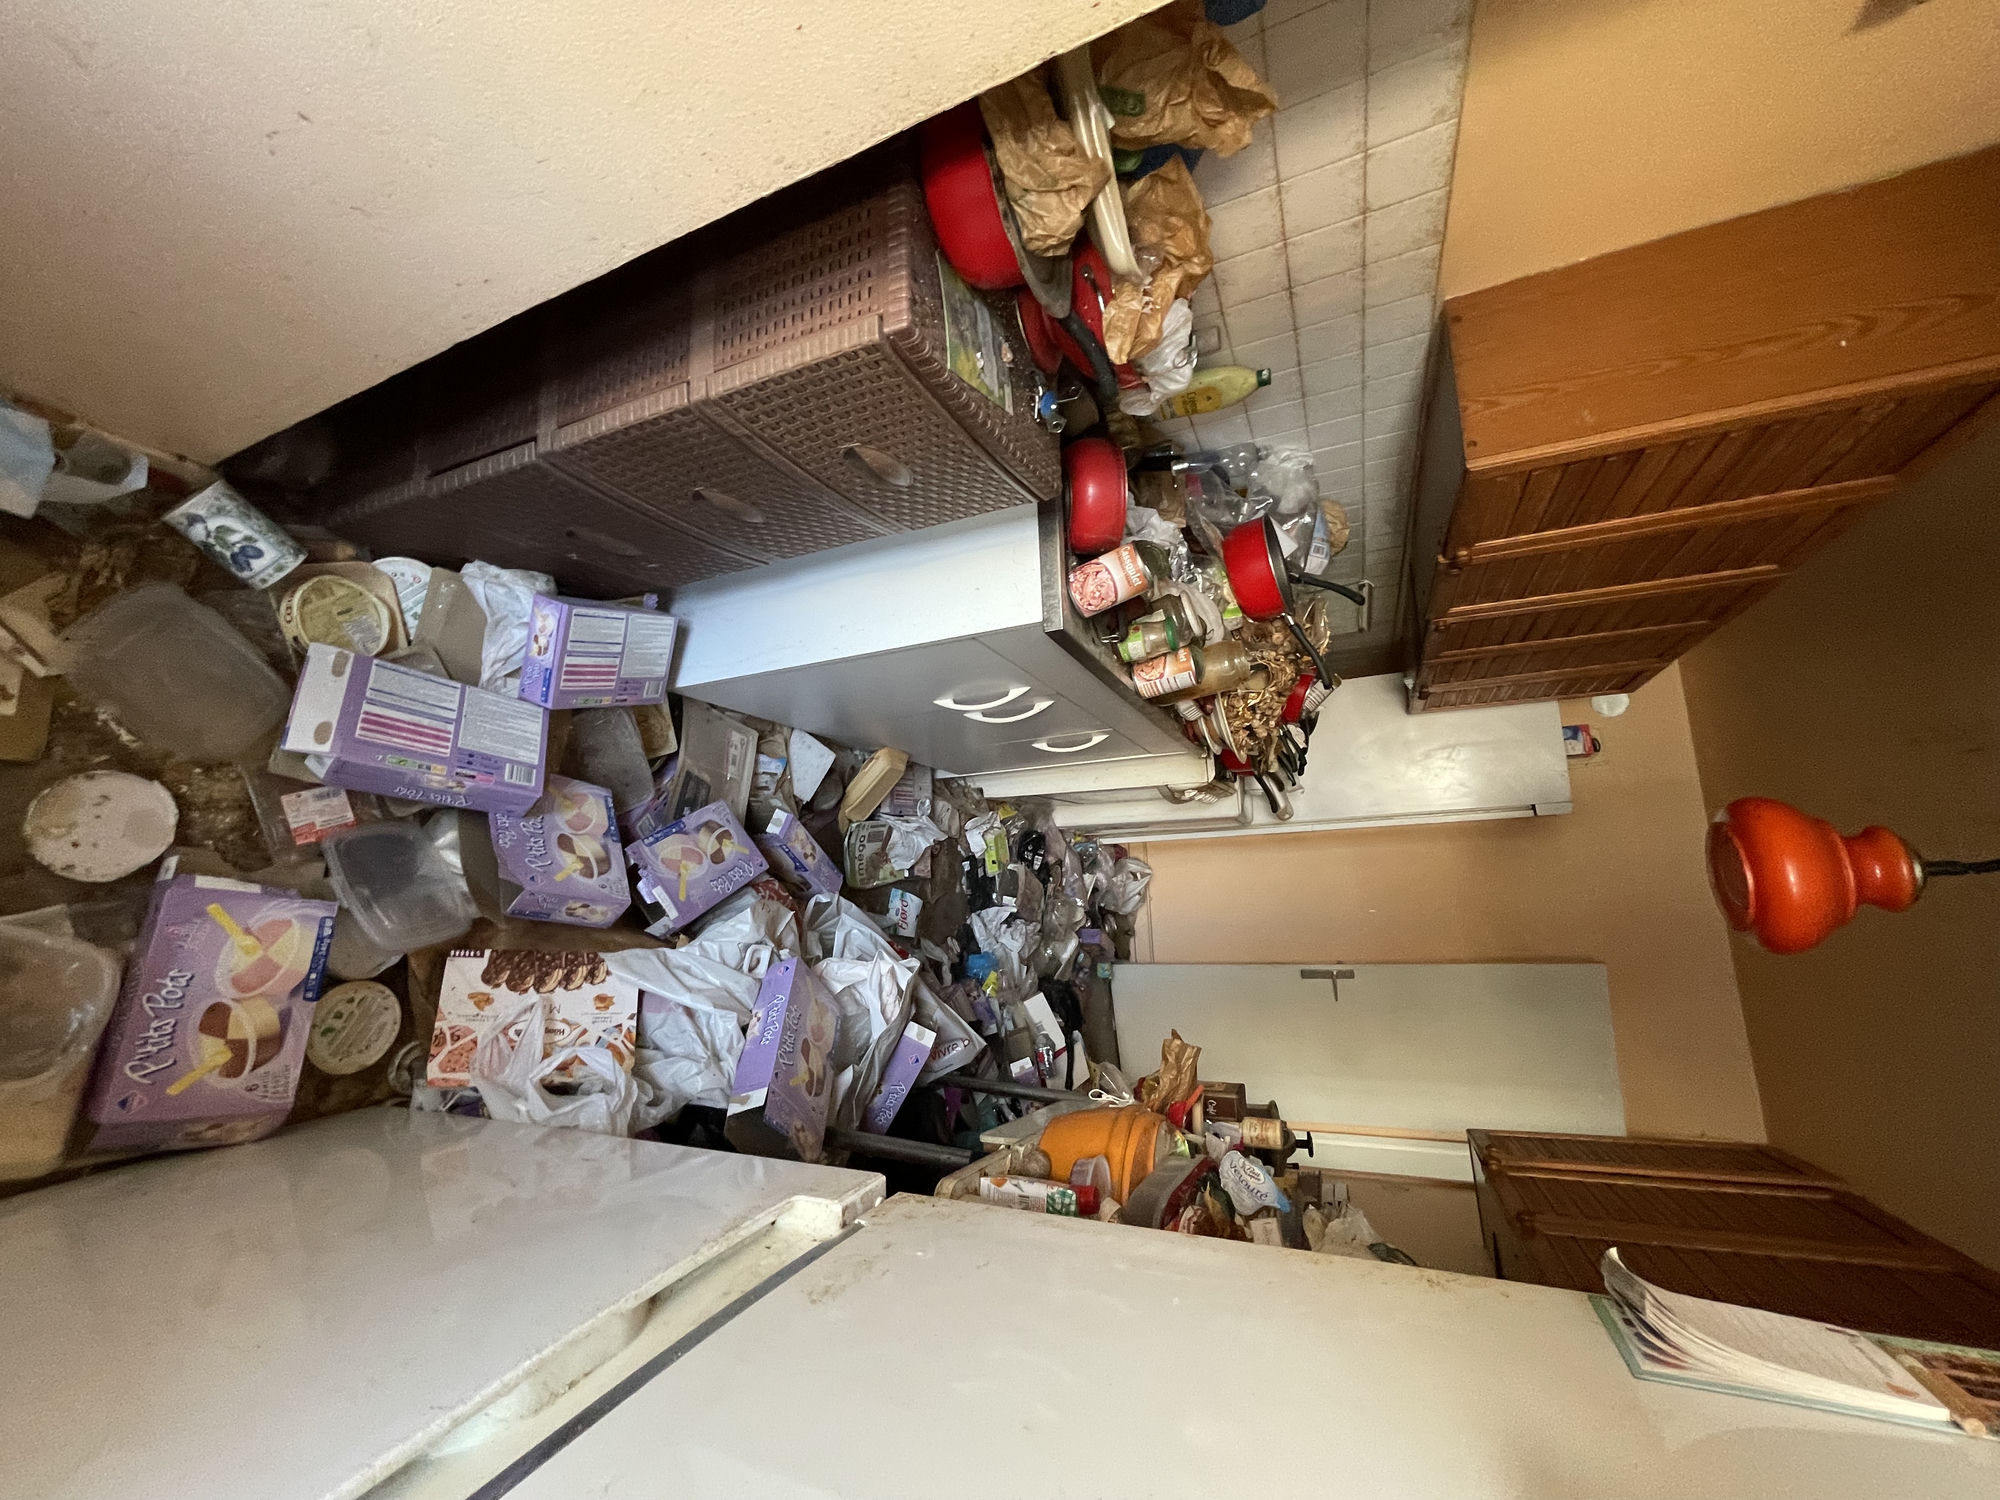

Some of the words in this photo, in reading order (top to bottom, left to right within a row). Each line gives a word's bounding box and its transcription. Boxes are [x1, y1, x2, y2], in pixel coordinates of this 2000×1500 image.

[1121, 546, 1142, 587] Cassoulet
[525, 837, 553, 871] P'tits
[709, 875, 733, 893] Pots
[727, 859, 754, 881] P'tits
[143, 967, 195, 1016] Pots
[767, 994, 785, 1022] P'tits
[760, 1021, 780, 1046] Pots
[779, 1031, 795, 1067] P'tits
[124, 1015, 177, 1084] P'tits
[1206, 1099, 1218, 1115] Café
